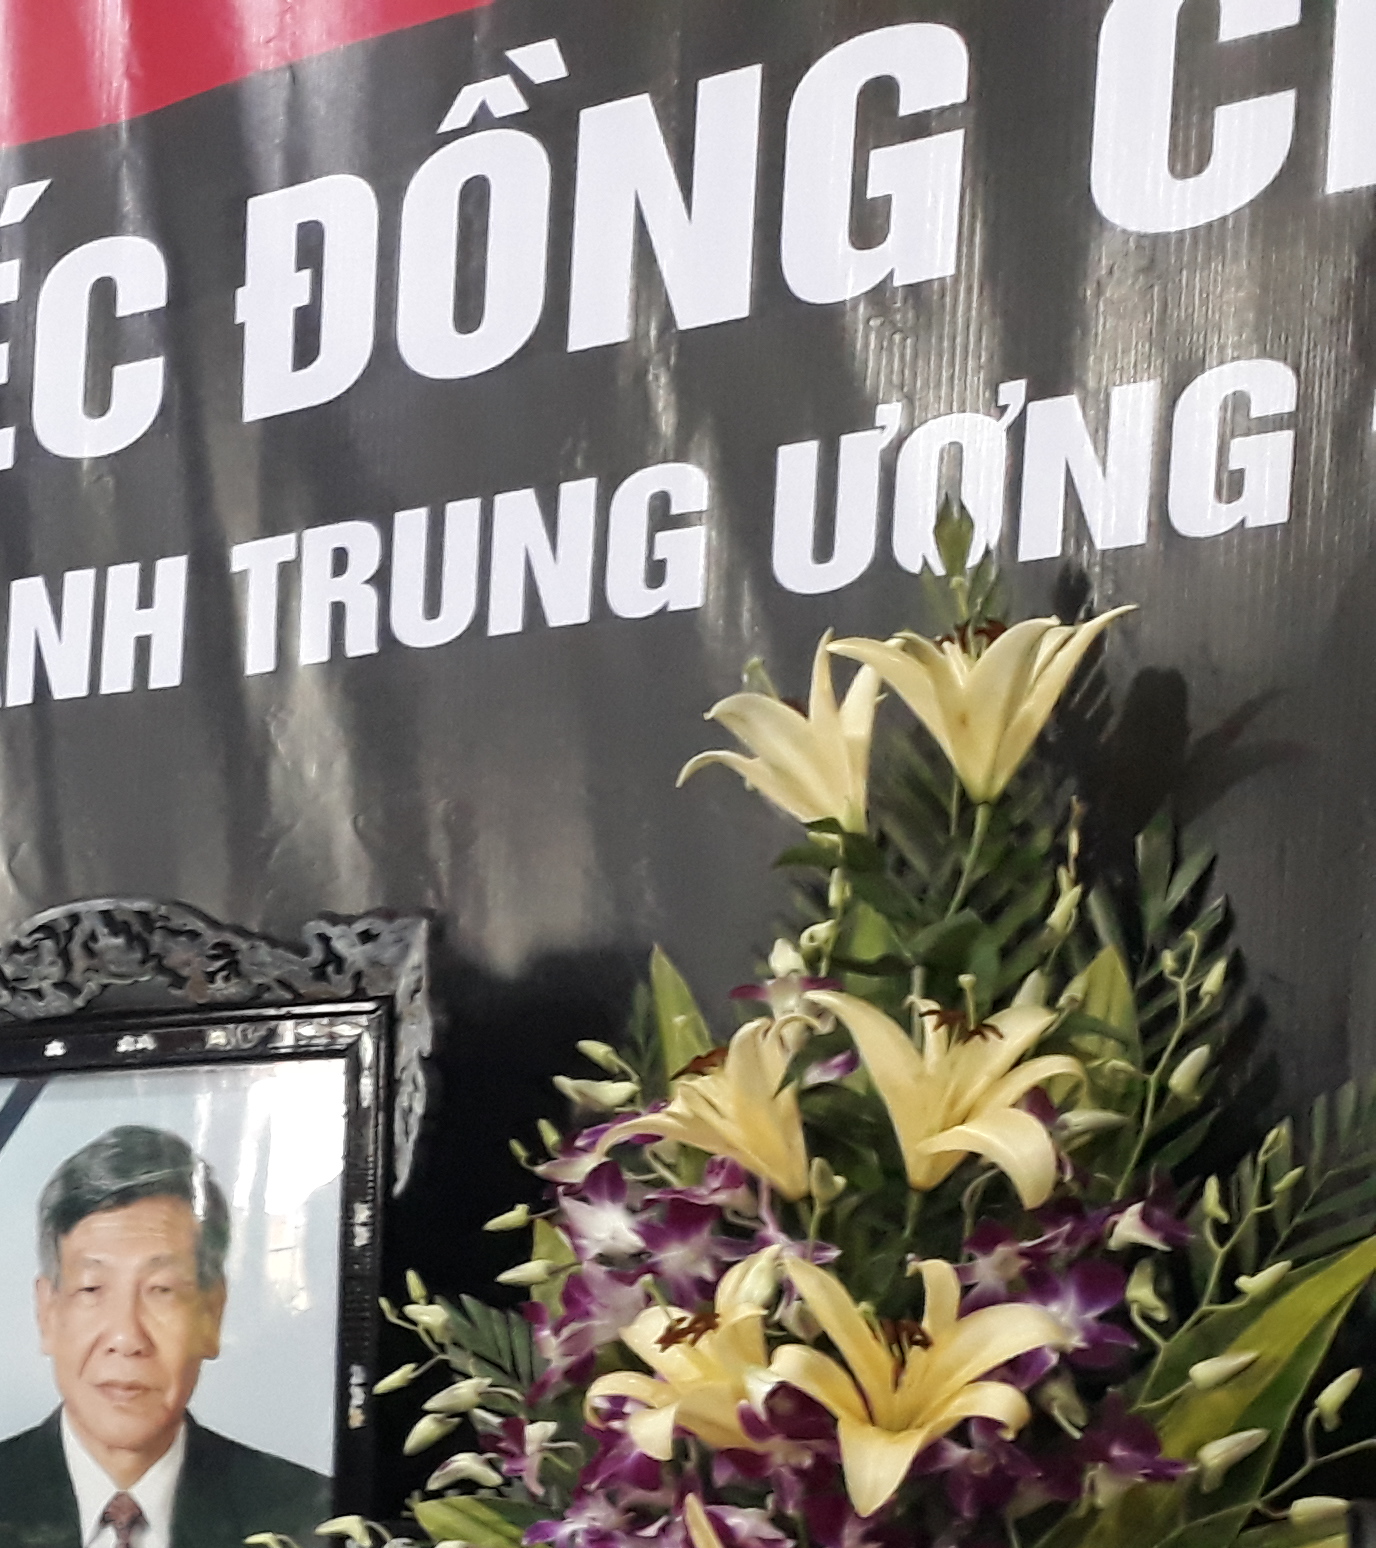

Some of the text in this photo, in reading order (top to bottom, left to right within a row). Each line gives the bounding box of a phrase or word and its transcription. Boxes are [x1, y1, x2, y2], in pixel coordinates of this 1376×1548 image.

[235, 22, 970, 423] ĐỒNG
[230, 463, 709, 677] TRUNG
[772, 359, 1298, 595] ƯƠNG
